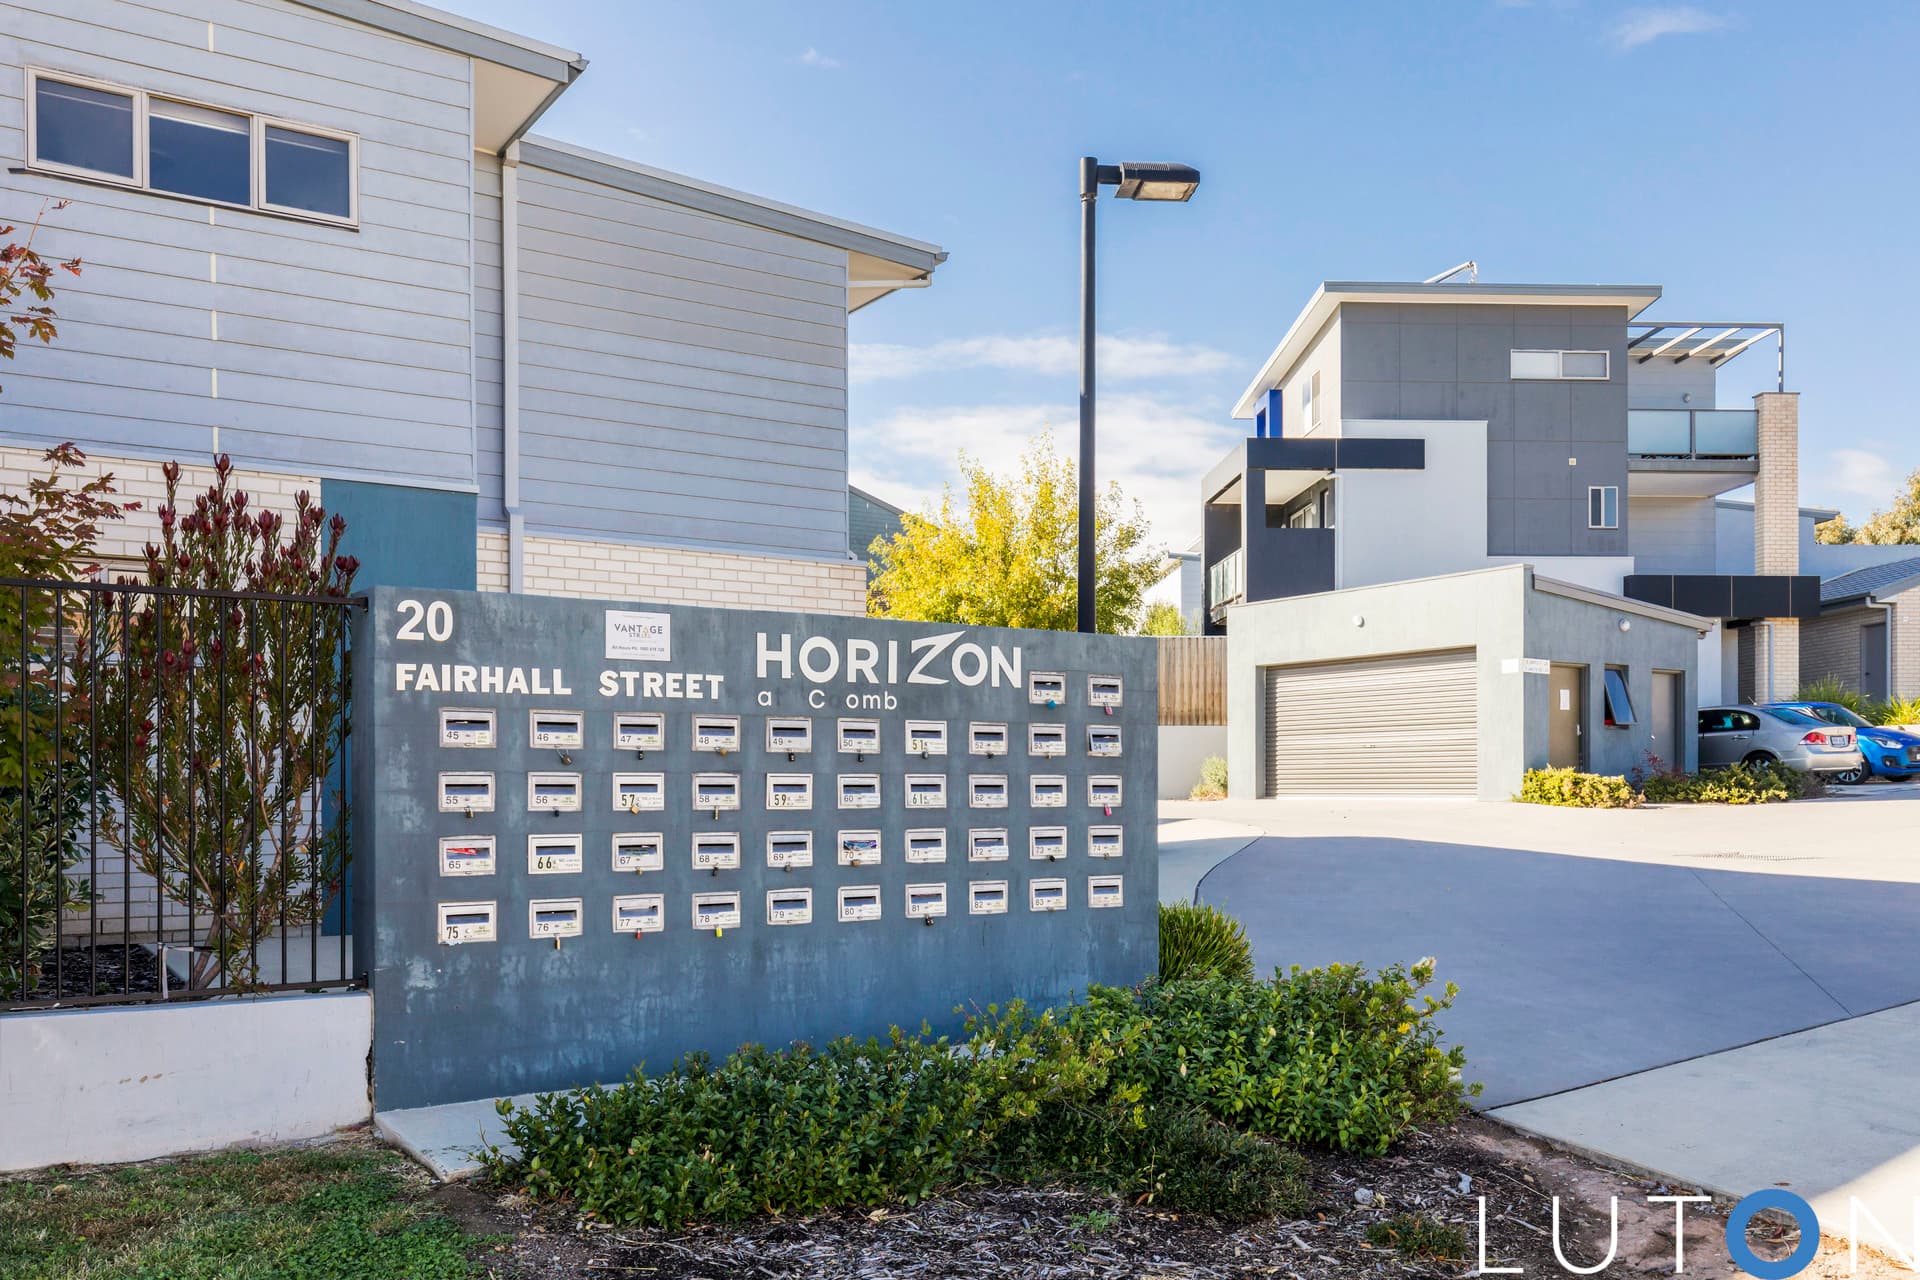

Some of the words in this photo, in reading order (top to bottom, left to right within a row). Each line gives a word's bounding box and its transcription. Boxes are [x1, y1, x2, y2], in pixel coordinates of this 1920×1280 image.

[396, 600, 454, 642] 20
[756, 630, 1022, 689] HORIZON
[396, 663, 573, 696] FAIRHALL
[598, 670, 725, 701] STREET
[446, 731, 459, 740] 45
[536, 733, 549, 742] 46
[620, 735, 632, 743] 47
[698, 737, 710, 745] 48
[772, 738, 784, 746] 49
[843, 739, 853, 747] 50
[912, 739, 924, 750] 51
[446, 795, 458, 805] 55
[535, 795, 548, 804] 56
[621, 794, 635, 807] 57
[699, 795, 710, 803] 58
[774, 793, 787, 806] 59
[912, 793, 923, 805] 61
[975, 794, 984, 802] 62
[843, 851, 854, 859] 70
[912, 849, 920, 857] 71
[975, 848, 984, 856] 72
[620, 856, 631, 864] 67
[699, 855, 710, 863] 68
[773, 853, 784, 861] 69
[448, 860, 461, 869] 65
[537, 856, 552, 870] 66
[699, 915, 710, 923] 78
[773, 911, 785, 919] 79
[619, 918, 631, 927] 77
[537, 923, 549, 932] 76
[446, 926, 459, 939] 75
